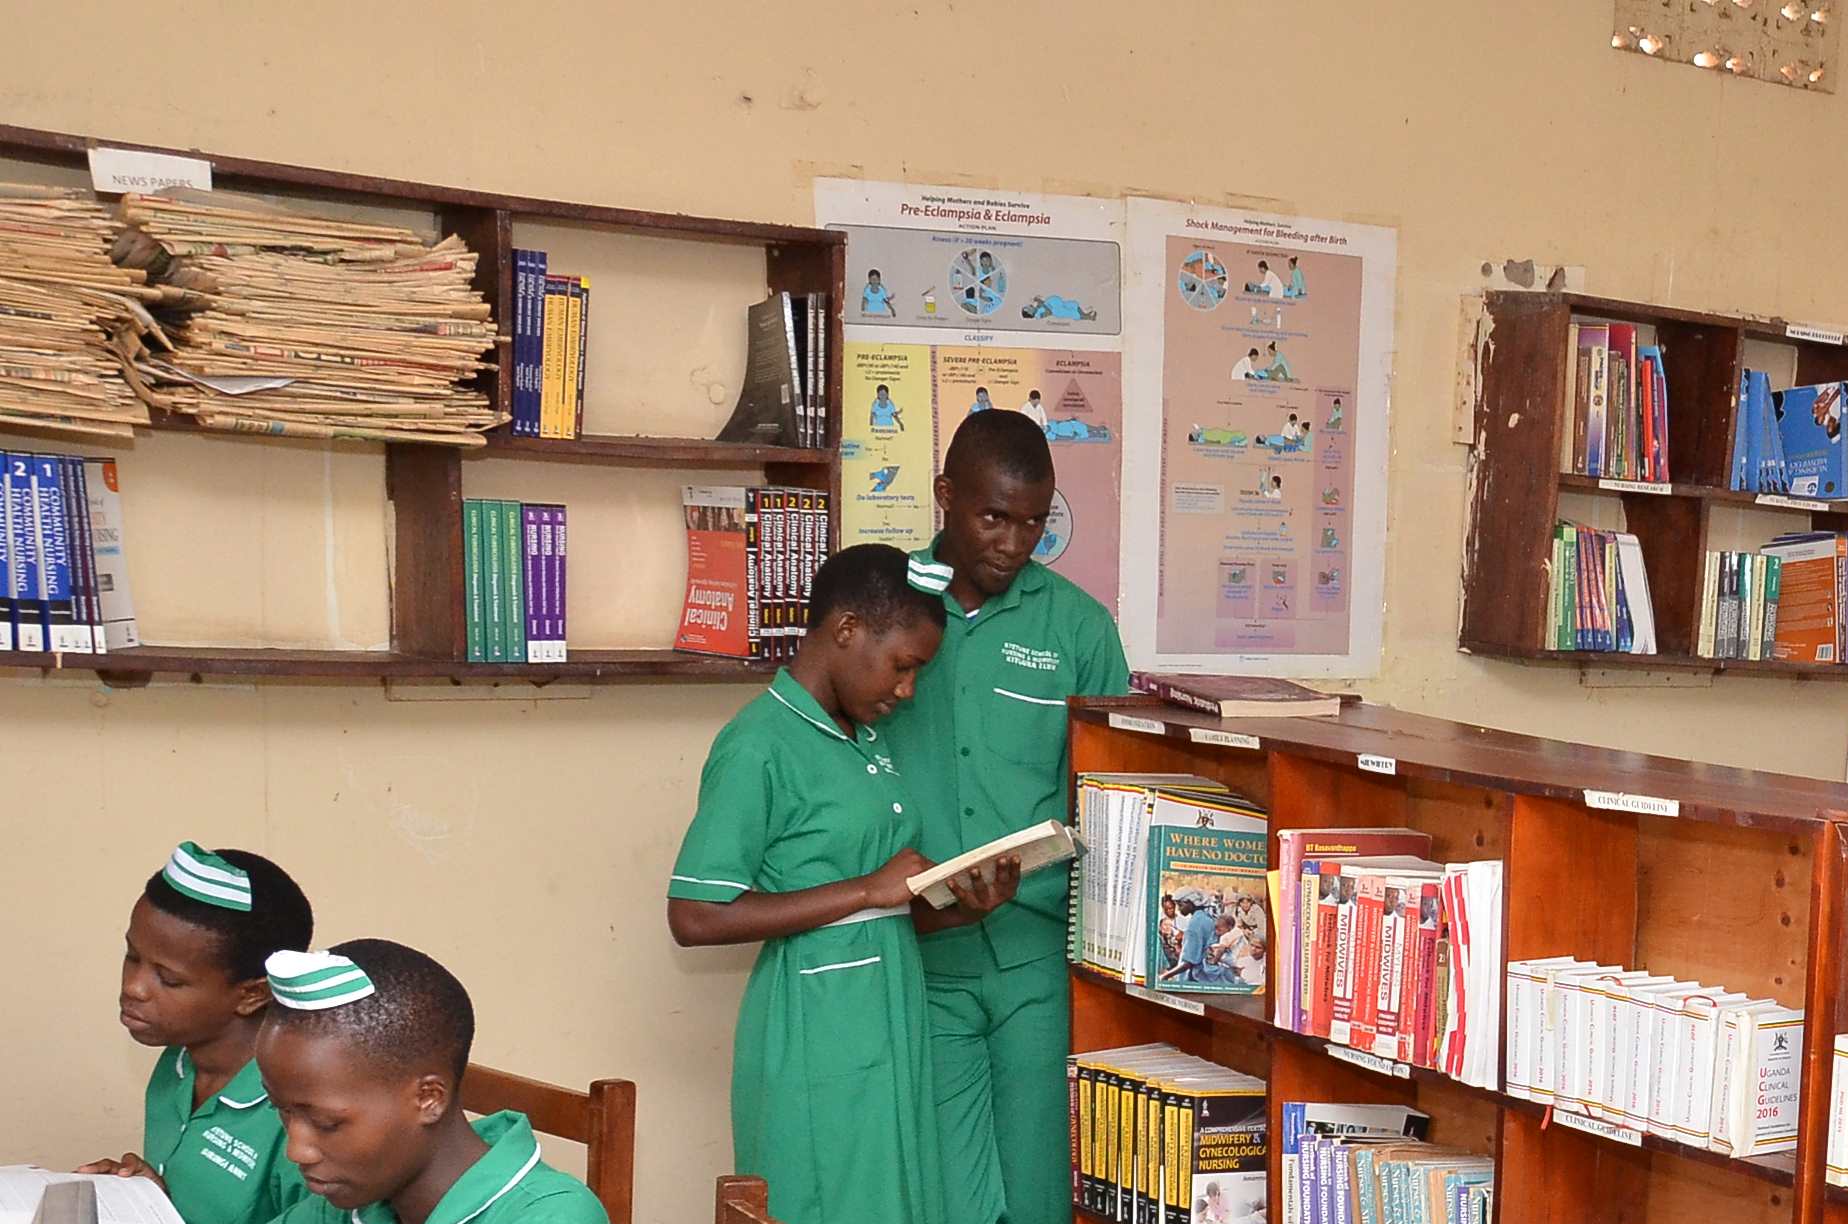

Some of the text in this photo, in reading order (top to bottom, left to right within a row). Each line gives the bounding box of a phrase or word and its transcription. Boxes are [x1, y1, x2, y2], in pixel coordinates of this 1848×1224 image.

[900, 203, 1050, 226] Pre-Eclampsia & Eclampsia
[1186, 218, 1347, 245] Shock Management for Bleeding after Birth
[14, 462, 27, 476] 2
[43, 464, 52, 477] 1
[51, 487, 67, 566] COMMUNITY
[38, 487, 59, 594] HEALTH NURSING
[788, 498, 799, 596] 2 Clinical Anatomy
[689, 585, 735, 612] Anatomy
[685, 607, 728, 631] Clinical
[1169, 832, 1265, 851] WHERE WOME
[1166, 846, 1267, 864] HAVE NO DOCTO
[1336, 913, 1348, 989] MIDWIVES
[1380, 925, 1393, 1001] MIDWIVES
[1200, 1134, 1261, 1146] MIDWIFERY &
[1200, 1146, 1266, 1157] GYNECOLOGICA
[1199, 1159, 1239, 1170] NURSING
